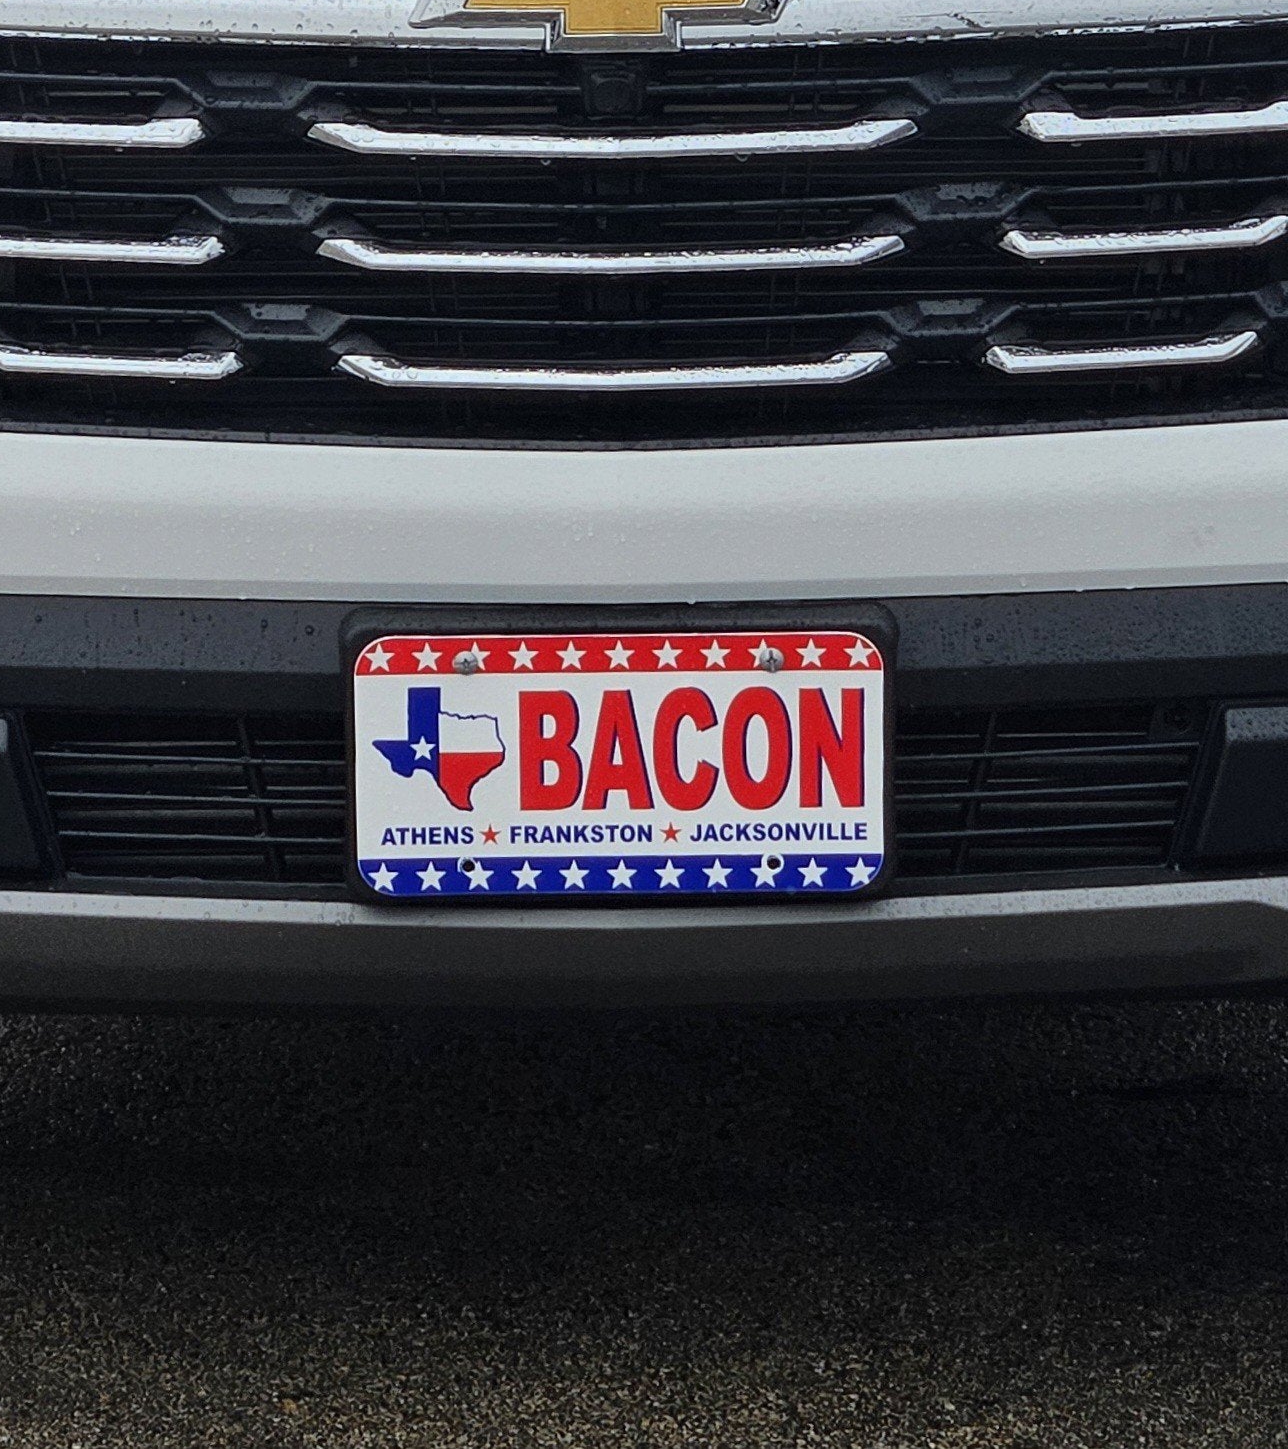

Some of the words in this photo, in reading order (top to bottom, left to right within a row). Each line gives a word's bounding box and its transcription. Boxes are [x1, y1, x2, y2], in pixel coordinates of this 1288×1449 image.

[518, 686, 865, 811] BACON
[381, 825, 475, 846] ATHENS
[510, 823, 654, 844] FRANKSTON
[689, 821, 868, 842] JACKSONVILLE
